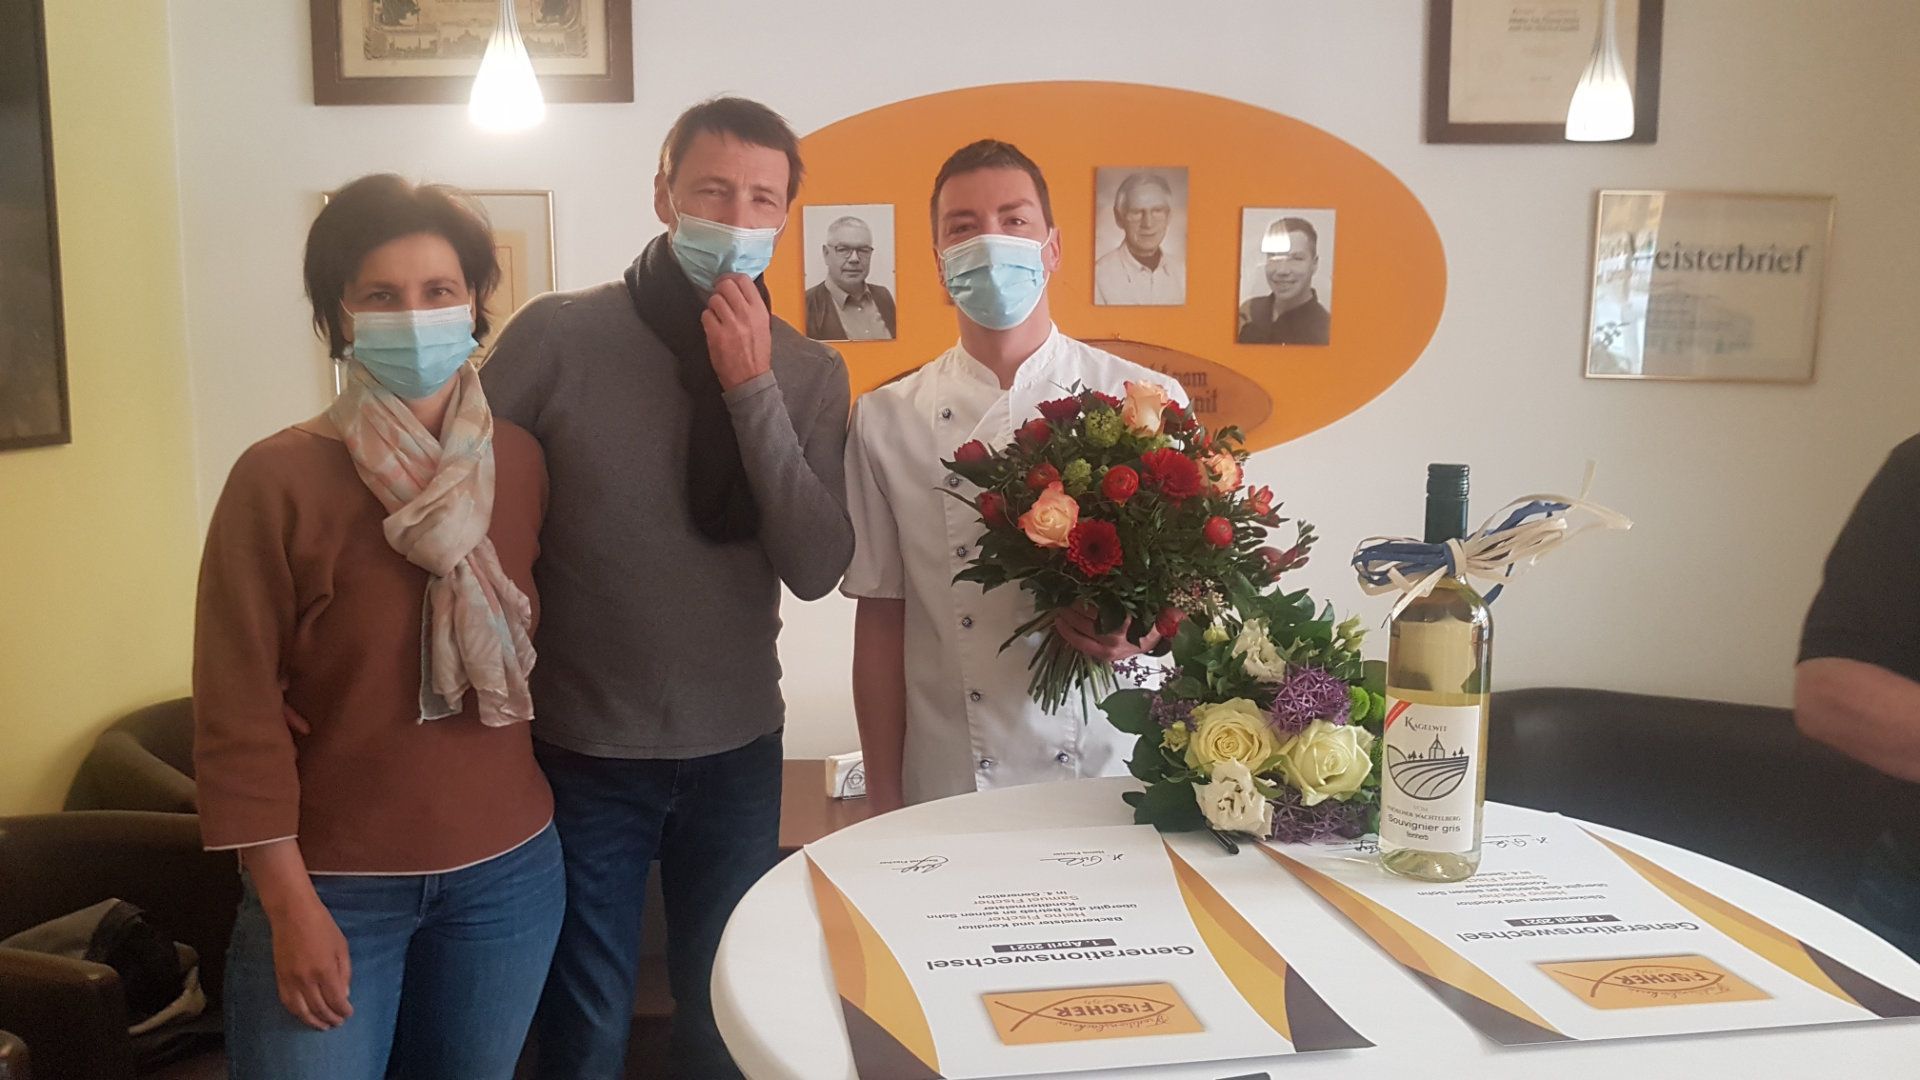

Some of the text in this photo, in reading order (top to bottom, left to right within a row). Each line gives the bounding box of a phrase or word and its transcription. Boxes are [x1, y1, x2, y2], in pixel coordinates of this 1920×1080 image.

[1388, 813, 1461, 834] Souvignier gris
[972, 894, 1079, 905] Samuel Fischer
[977, 891, 1040, 899] Generation
[983, 901, 1076, 910] Konditormeister
[987, 914, 1040, 922] Fischer
[1038, 916, 1123, 926] Bäckermeister
[1555, 915, 1587, 924] April
[957, 922, 1009, 930] Konditor
[1456, 921, 1700, 942] Generationswechsel
[1009, 943, 1043, 951] 2021
[1047, 940, 1083, 949] April
[926, 945, 1194, 970] Generationswechsel
[1613, 972, 1709, 985] FISCHER
[1053, 1002, 1155, 1017] FISCHER
